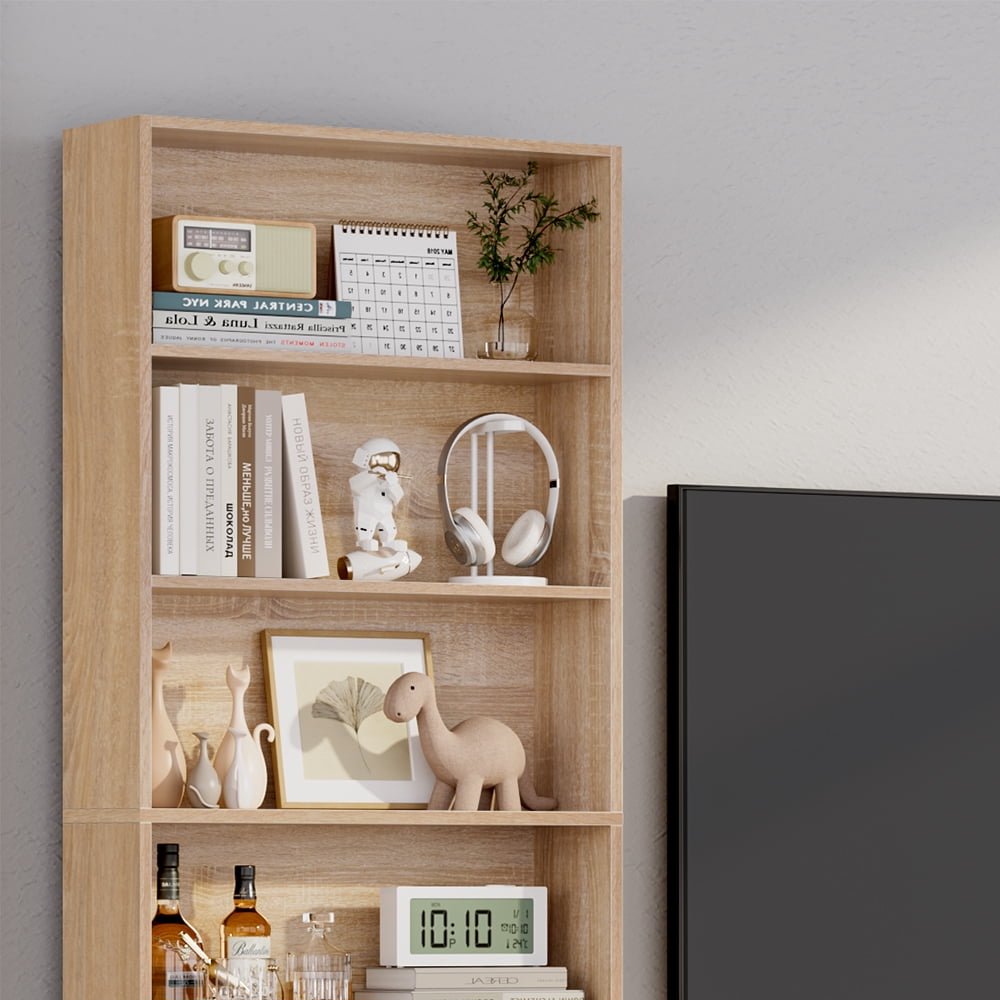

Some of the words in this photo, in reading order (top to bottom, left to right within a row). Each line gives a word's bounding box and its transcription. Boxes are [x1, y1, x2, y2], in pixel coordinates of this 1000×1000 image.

[205, 418, 214, 462] ЗАБОТА
[292, 418, 309, 463] НОВЫЙ
[205, 467, 214, 475] О
[298, 466, 313, 505] ОБРАЗ
[205, 478, 214, 552] ПРЕДАННЫХ
[224, 503, 233, 558] ШОКОЛАД
[304, 508, 320, 554] ЖИЗНИ
[242, 524, 251, 560] ЛУЧШЕ
[421, 910, 492, 948] 10:10
[449, 938, 456, 948] P
